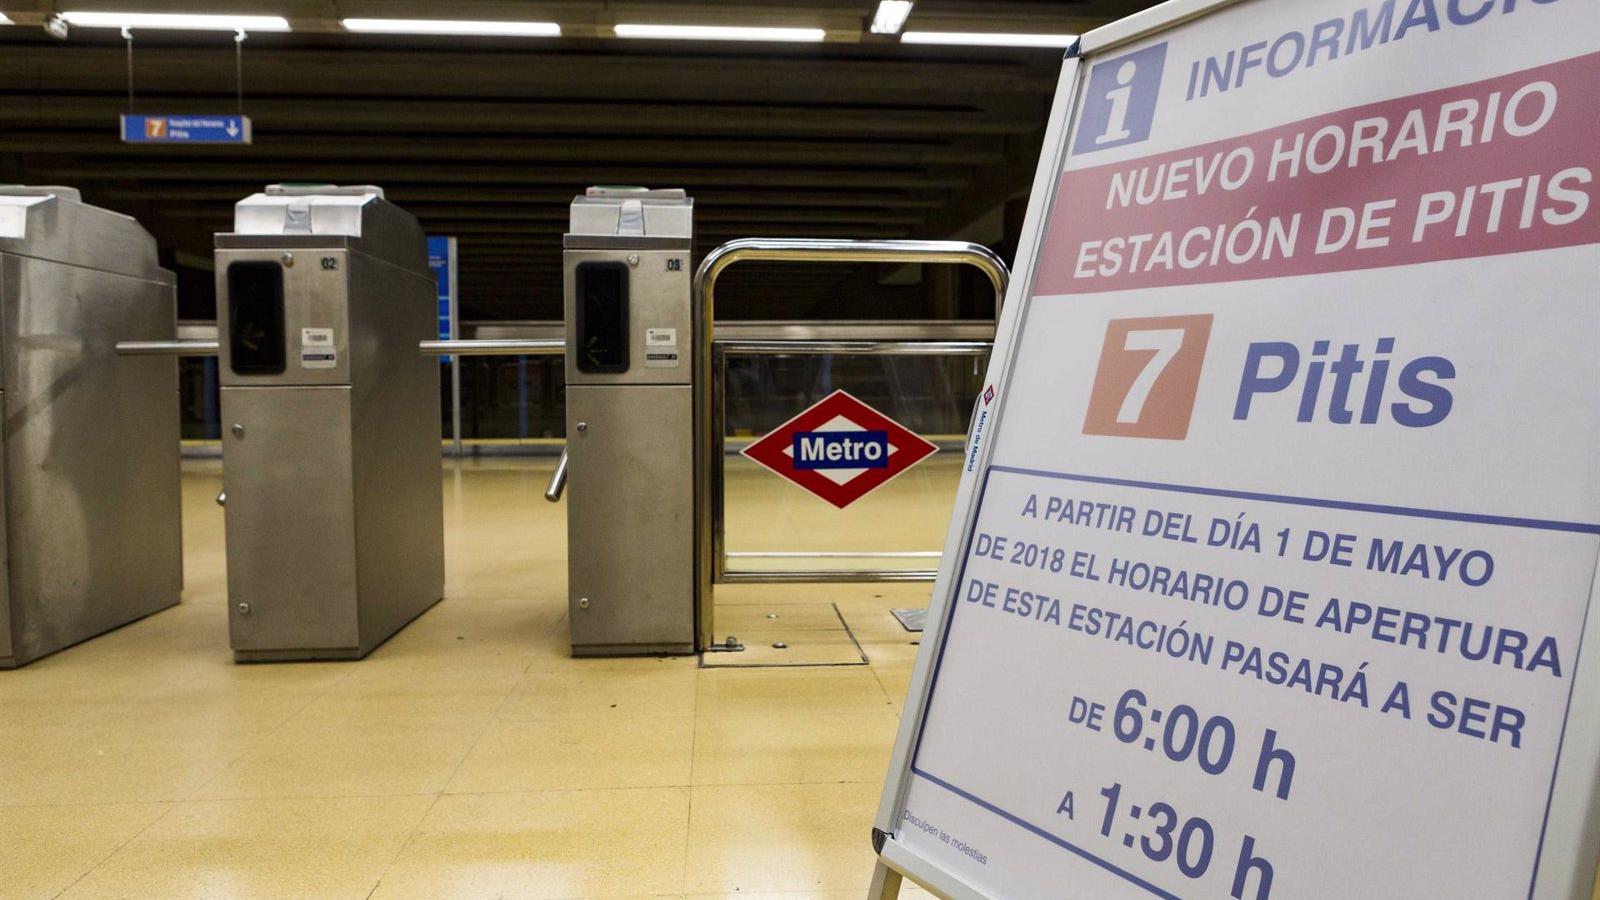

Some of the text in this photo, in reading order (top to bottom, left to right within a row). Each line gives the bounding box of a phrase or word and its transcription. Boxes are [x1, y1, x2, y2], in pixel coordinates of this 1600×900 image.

[149, 119, 163, 137] 7
[1105, 80, 1558, 210] NUEVO HORARIO
[321, 257, 336, 270] 02
[1073, 166, 1593, 279] ESTACIÓN DE PITIS
[977, 410, 987, 433] Metro
[1115, 328, 1456, 428] 7 Pitis
[801, 437, 882, 461] Metro
[967, 446, 979, 472] Madrid
[1021, 494, 1494, 587] A PARTIR DEL DÍA 1 DE MAYO
[975, 533, 1563, 678] DE 2018 EL HORARIO DE APERTURA
[966, 579, 1526, 749] DE ESTA ESTACIÓN PASARÁ A SER
[1068, 689, 1296, 800] DE 6:00 h
[903, 809, 988, 865] Disculpen las molestias
[1056, 783, 1274, 900] A 1:30 h
